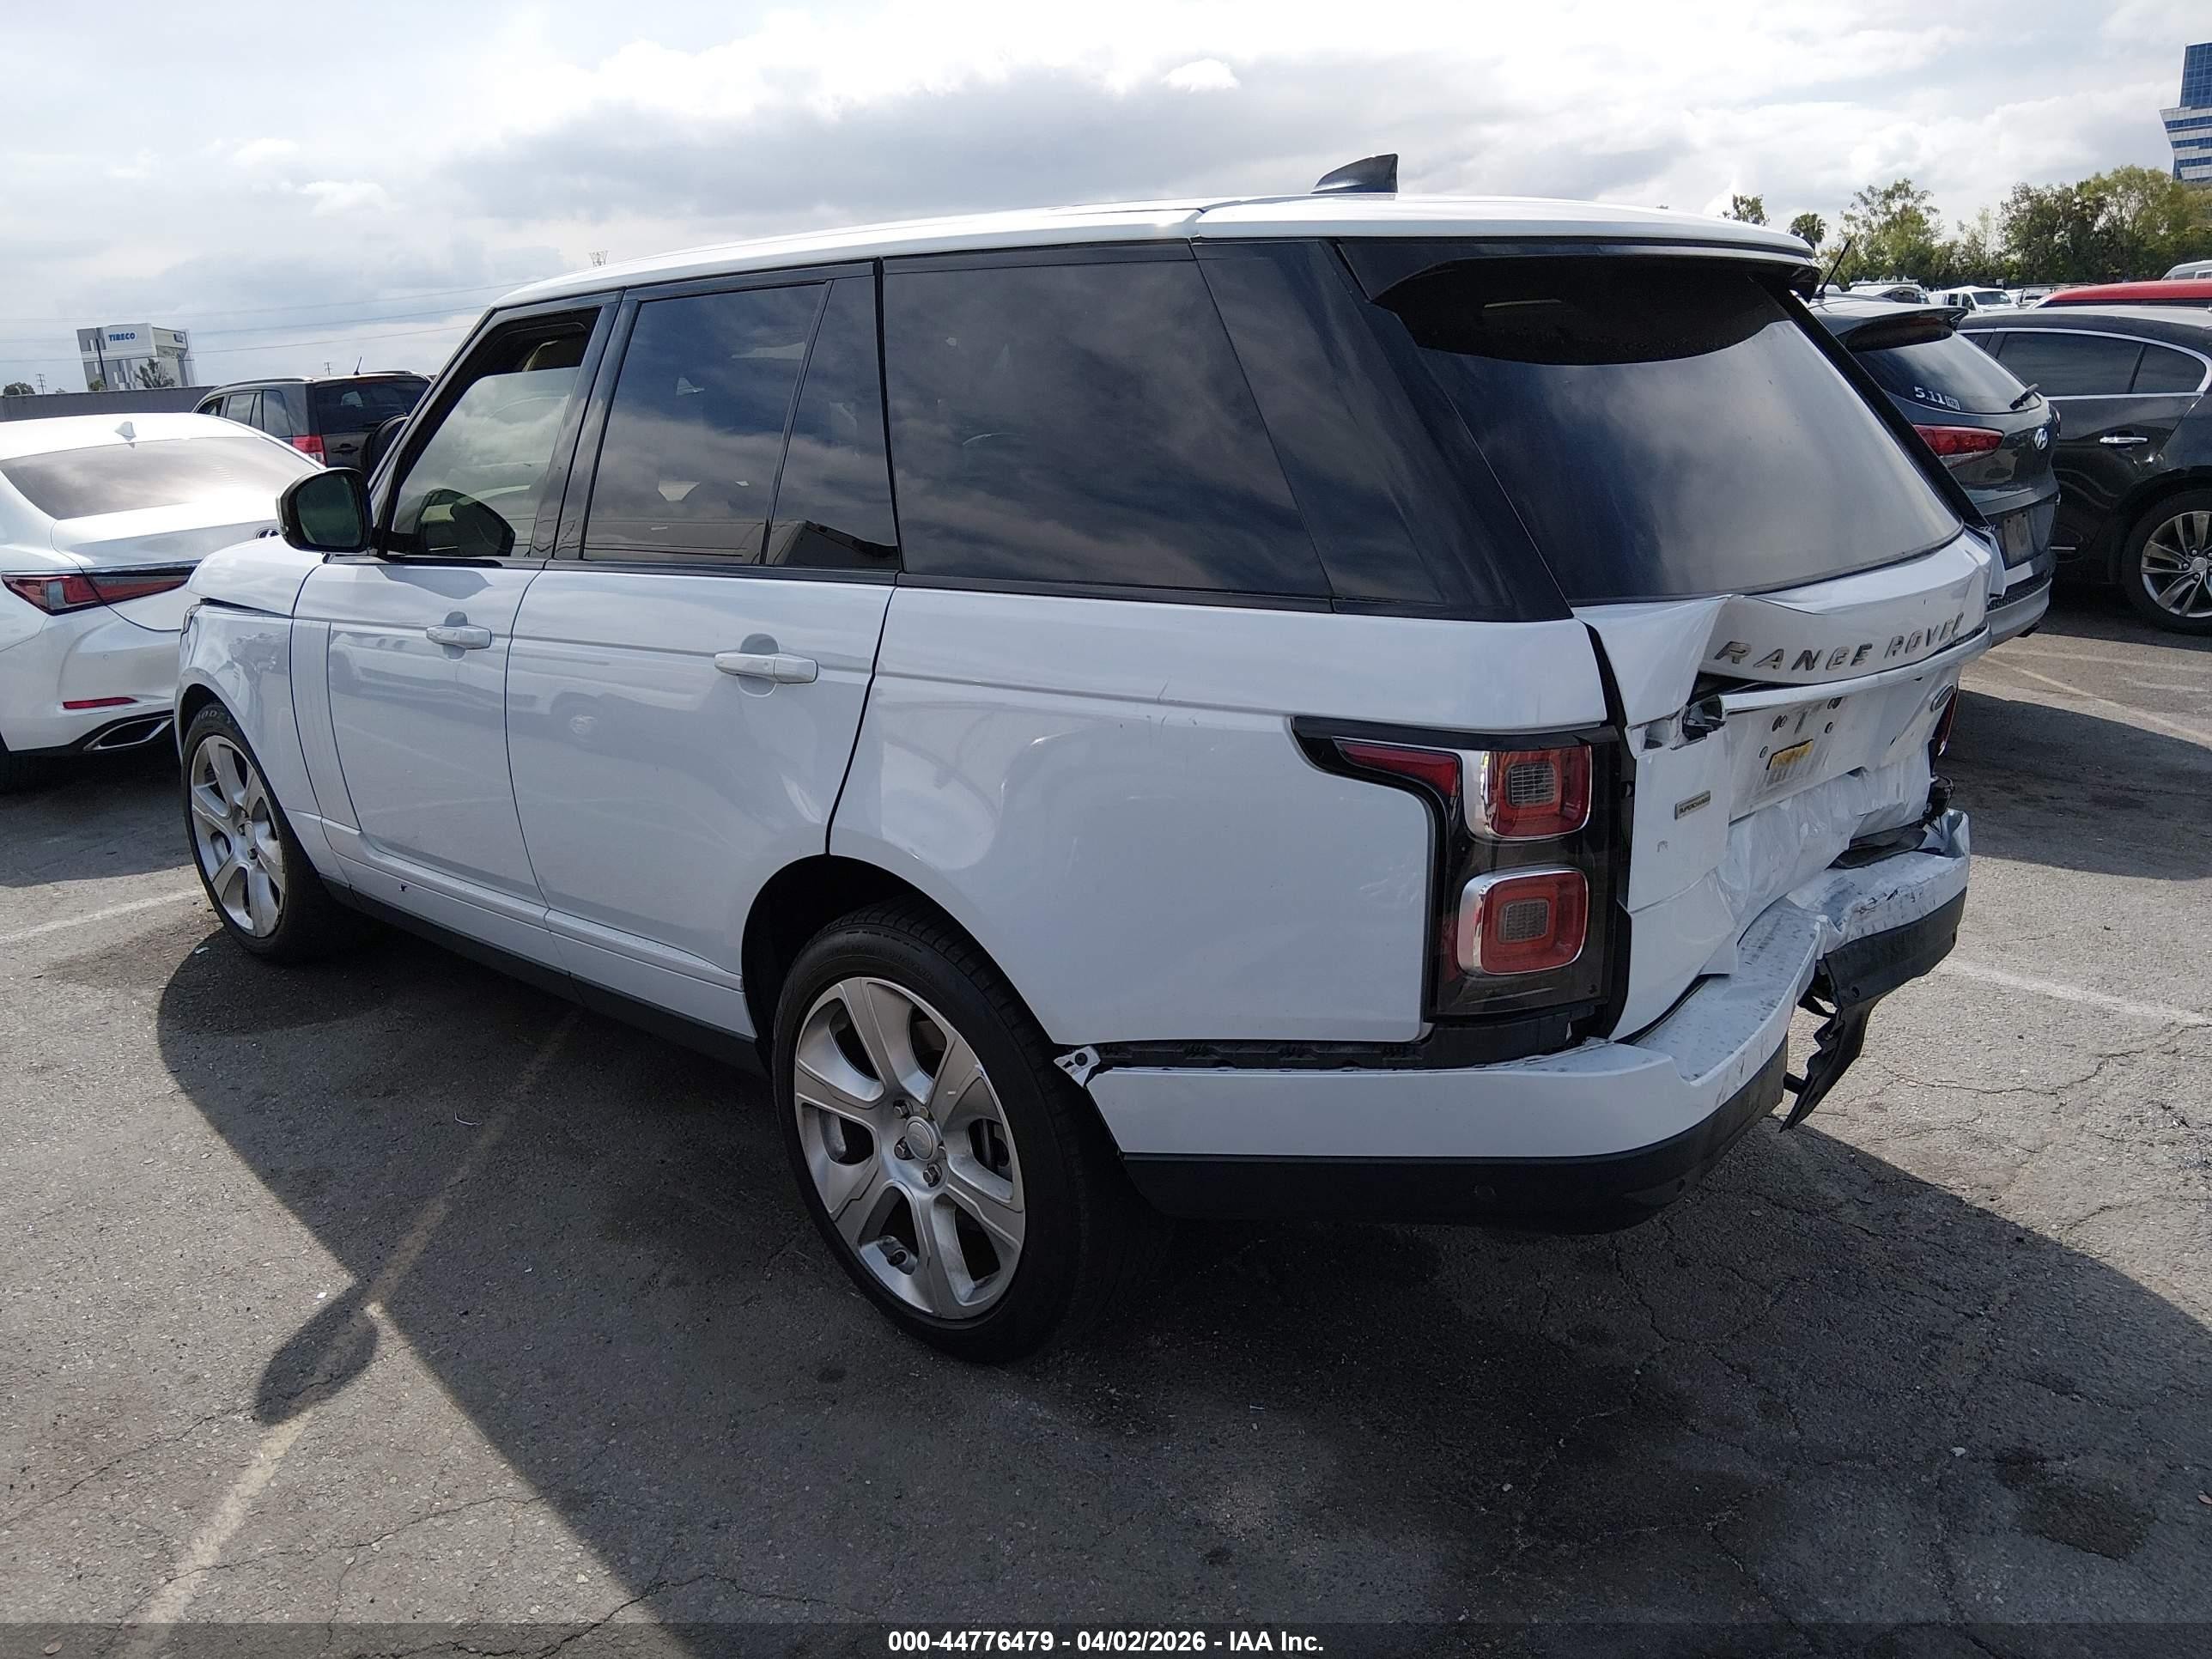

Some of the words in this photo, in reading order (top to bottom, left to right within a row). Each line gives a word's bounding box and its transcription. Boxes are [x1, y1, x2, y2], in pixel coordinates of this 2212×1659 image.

[108, 332, 136, 342] TIRECO
[1914, 386, 1946, 404] 5.11
[1714, 640, 1873, 672] RANGE
